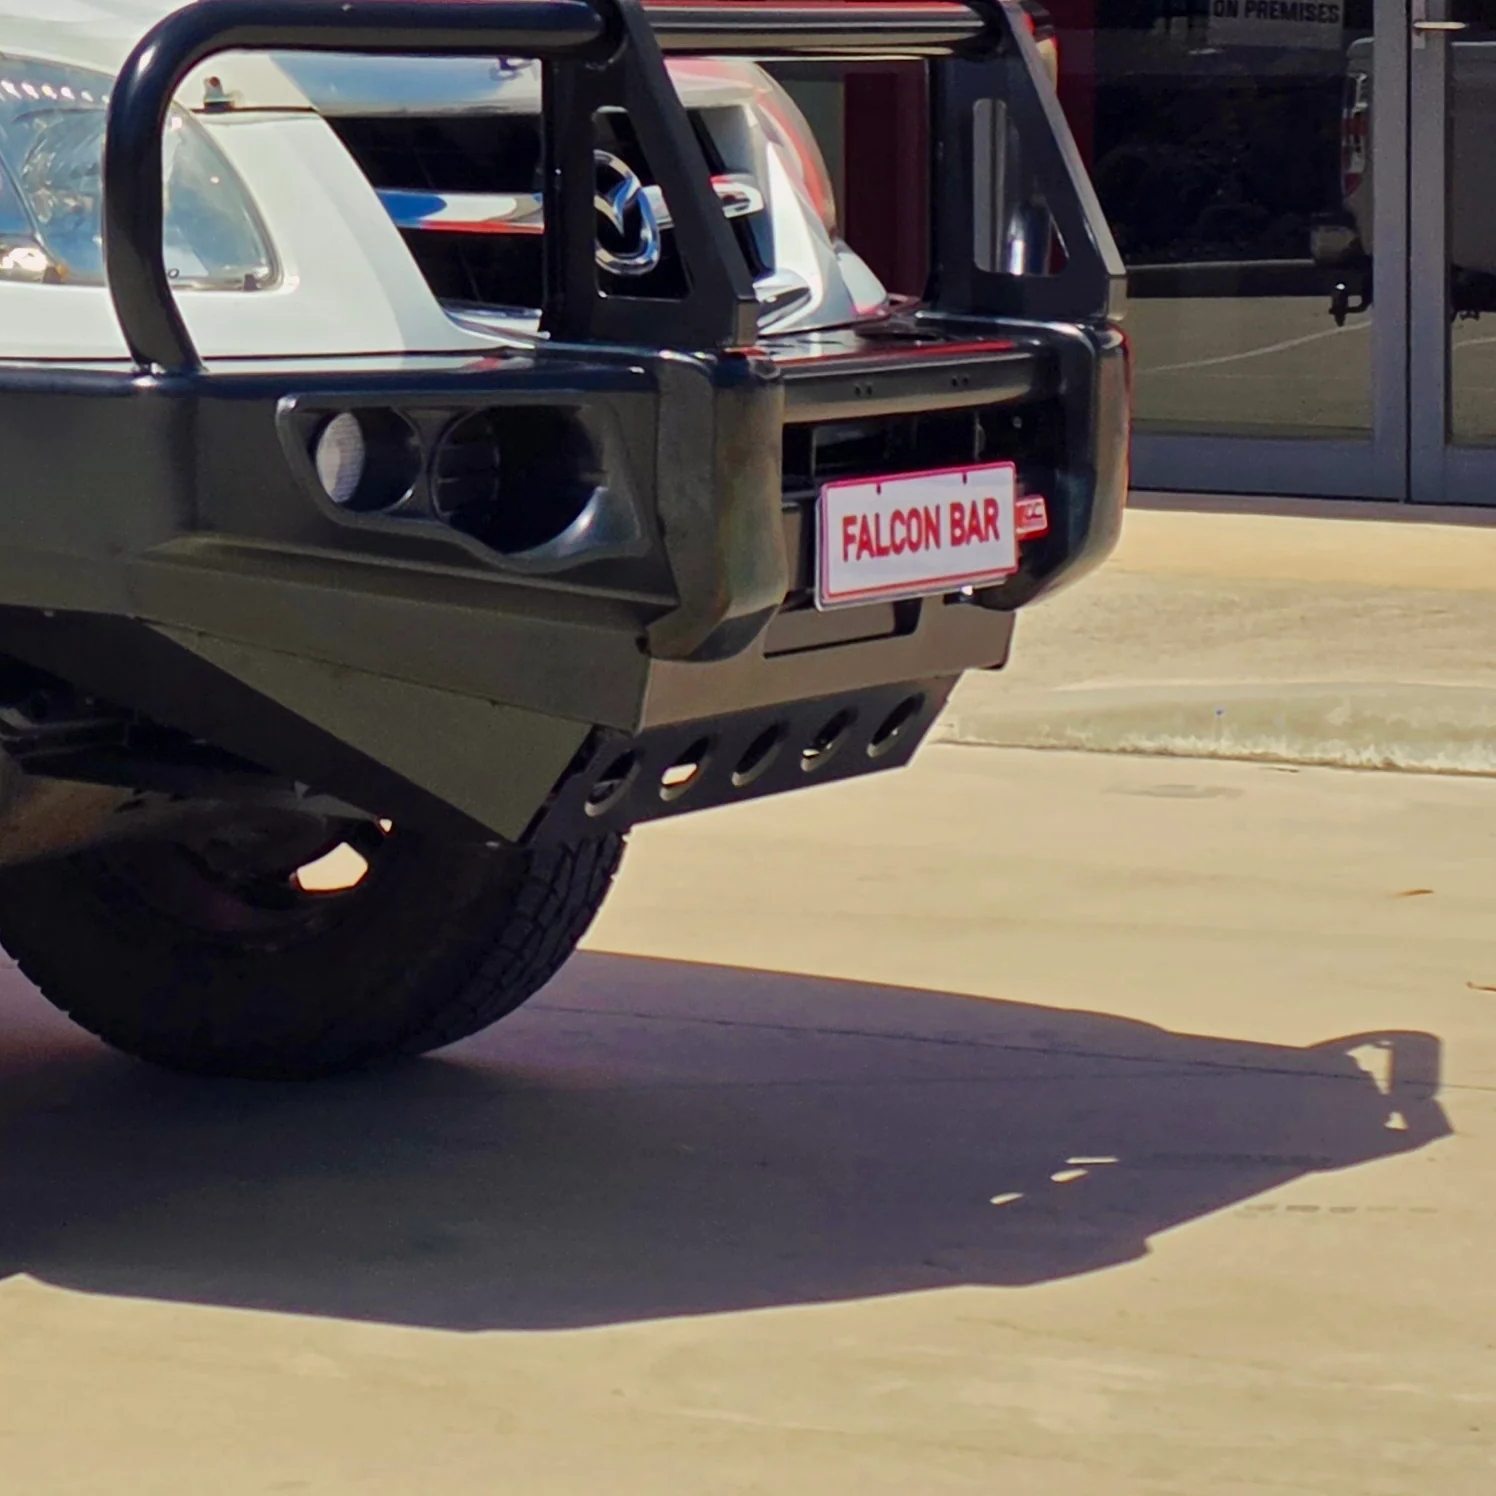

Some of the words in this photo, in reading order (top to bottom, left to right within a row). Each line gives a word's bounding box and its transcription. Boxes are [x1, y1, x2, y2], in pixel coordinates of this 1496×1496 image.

[1244, 0, 1340, 23] PREMISES
[842, 505, 941, 562] FALCON
[950, 498, 1000, 547] BAR
